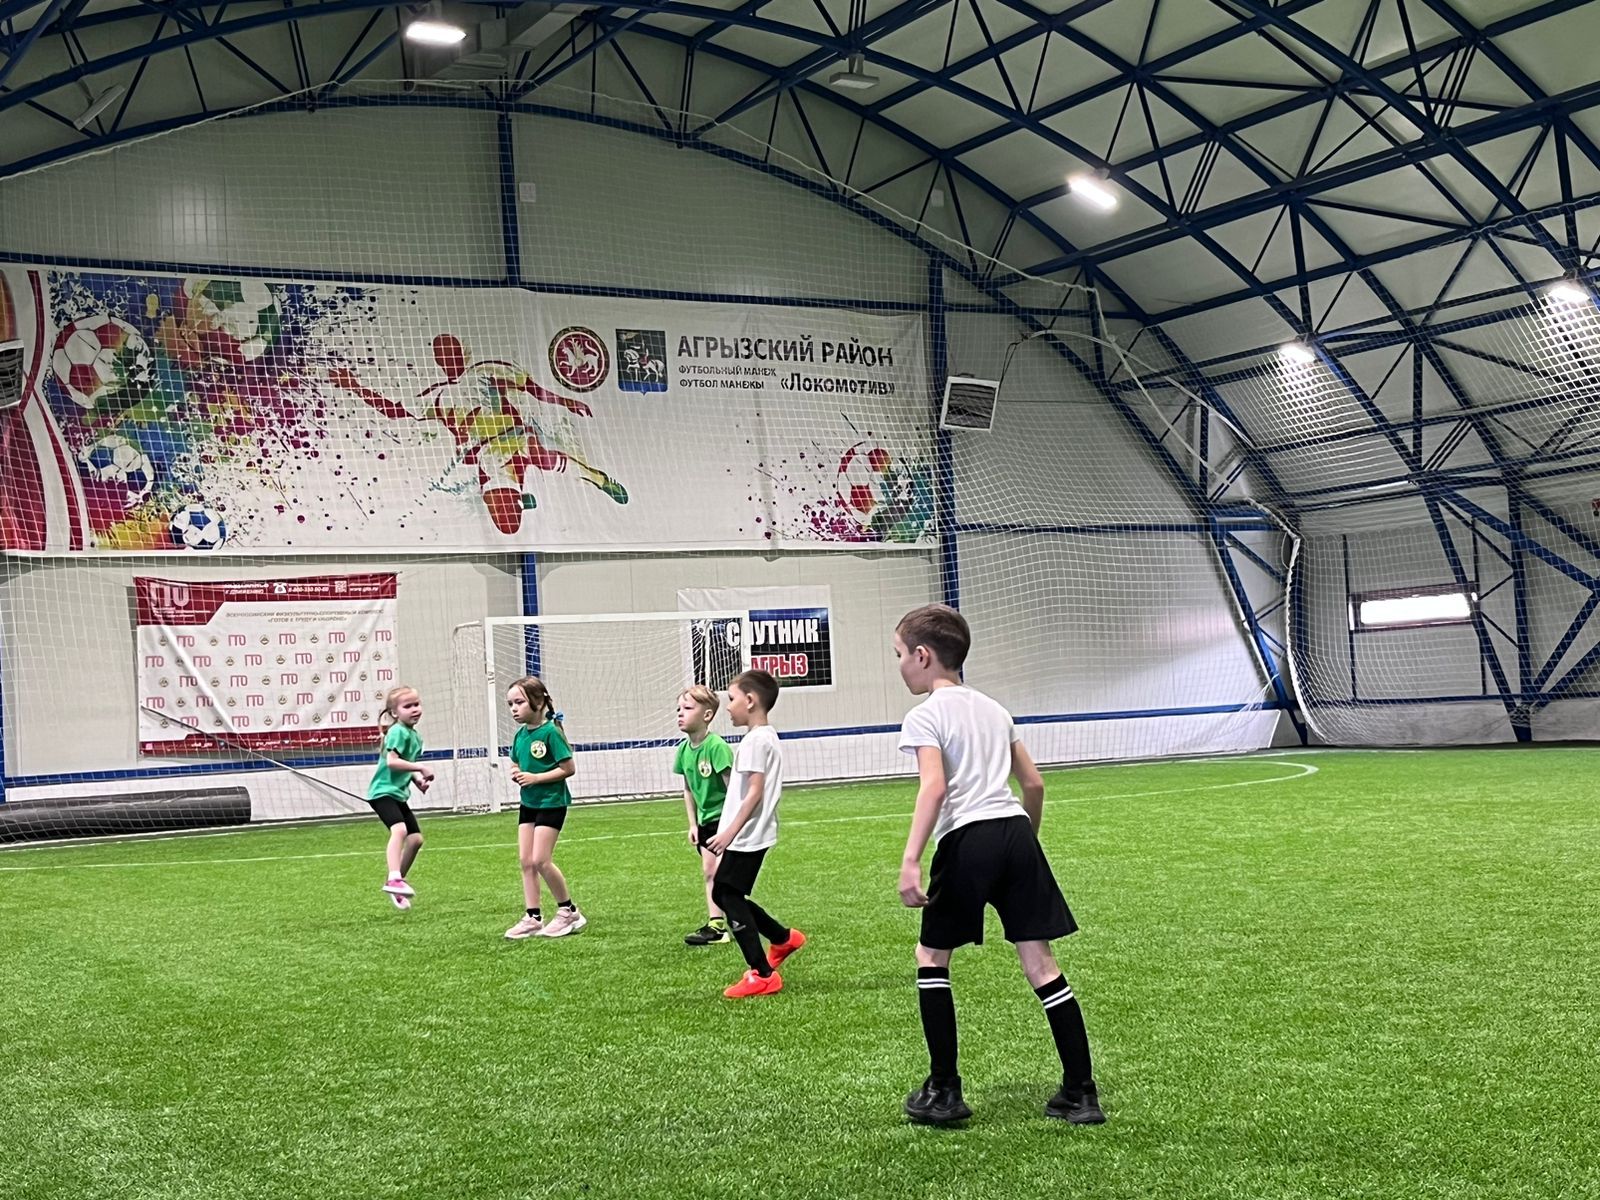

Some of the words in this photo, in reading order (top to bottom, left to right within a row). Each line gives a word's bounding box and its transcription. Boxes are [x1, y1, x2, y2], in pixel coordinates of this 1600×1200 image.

[677, 334, 814, 363] АГРЫЗСКИЙ
[821, 337, 894, 367] РАЙОН
[678, 364, 742, 376] ФУТБОЛЬНЫЙ
[743, 367, 777, 377] МАНЕЖ
[679, 378, 718, 389] ФУТБОЛ
[176, 635, 195, 648] ГТО
[228, 634, 247, 647] ГТО
[279, 633, 297, 645] ГТО
[328, 632, 346, 644] ГТО
[375, 630, 392, 642] ГТО
[145, 656, 164, 668] ГТО
[193, 655, 212, 668] ГТО
[244, 654, 263, 667] ГТО
[295, 652, 313, 665] ГТО
[343, 651, 360, 663] ГТО
[179, 676, 198, 688] ГТО
[230, 675, 248, 688] ГТО
[280, 673, 298, 686] ГТО
[329, 671, 347, 684] ГТО
[377, 669, 393, 681] ГТО
[146, 697, 165, 710] ГТО
[246, 694, 264, 708] ГТО
[296, 692, 314, 705] ГТО
[344, 690, 361, 703] ГТО
[232, 715, 250, 728] ГТО
[282, 713, 300, 726] ГТО
[331, 711, 348, 723] ГТО
